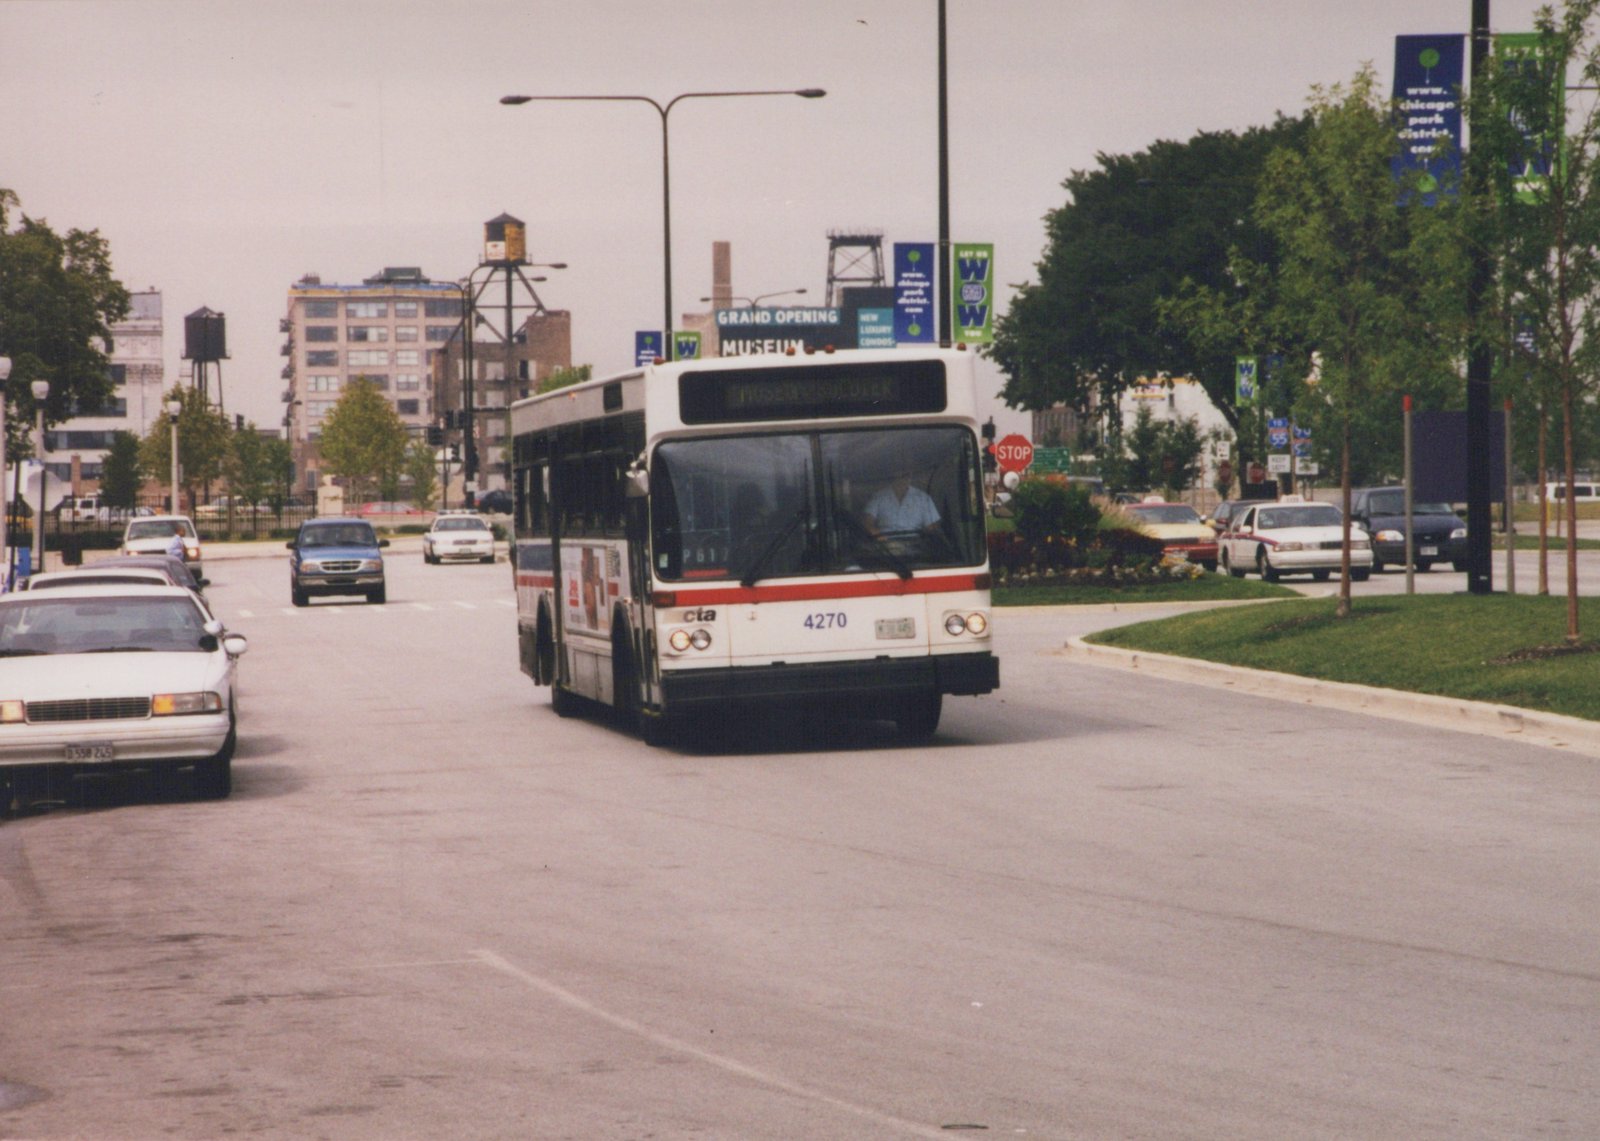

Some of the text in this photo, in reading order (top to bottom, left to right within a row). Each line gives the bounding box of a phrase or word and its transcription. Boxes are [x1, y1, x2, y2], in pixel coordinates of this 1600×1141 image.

[1406, 87, 1448, 95] www.
[1399, 99, 1455, 111] chicago
[1408, 113, 1444, 126] park
[718, 310, 838, 325] GRAND OPENING
[722, 339, 804, 357] MUSEUM
[1271, 433, 1288, 445] 55
[998, 446, 1031, 460] STOP
[683, 607, 717, 622] cta
[803, 612, 847, 629] 4270
